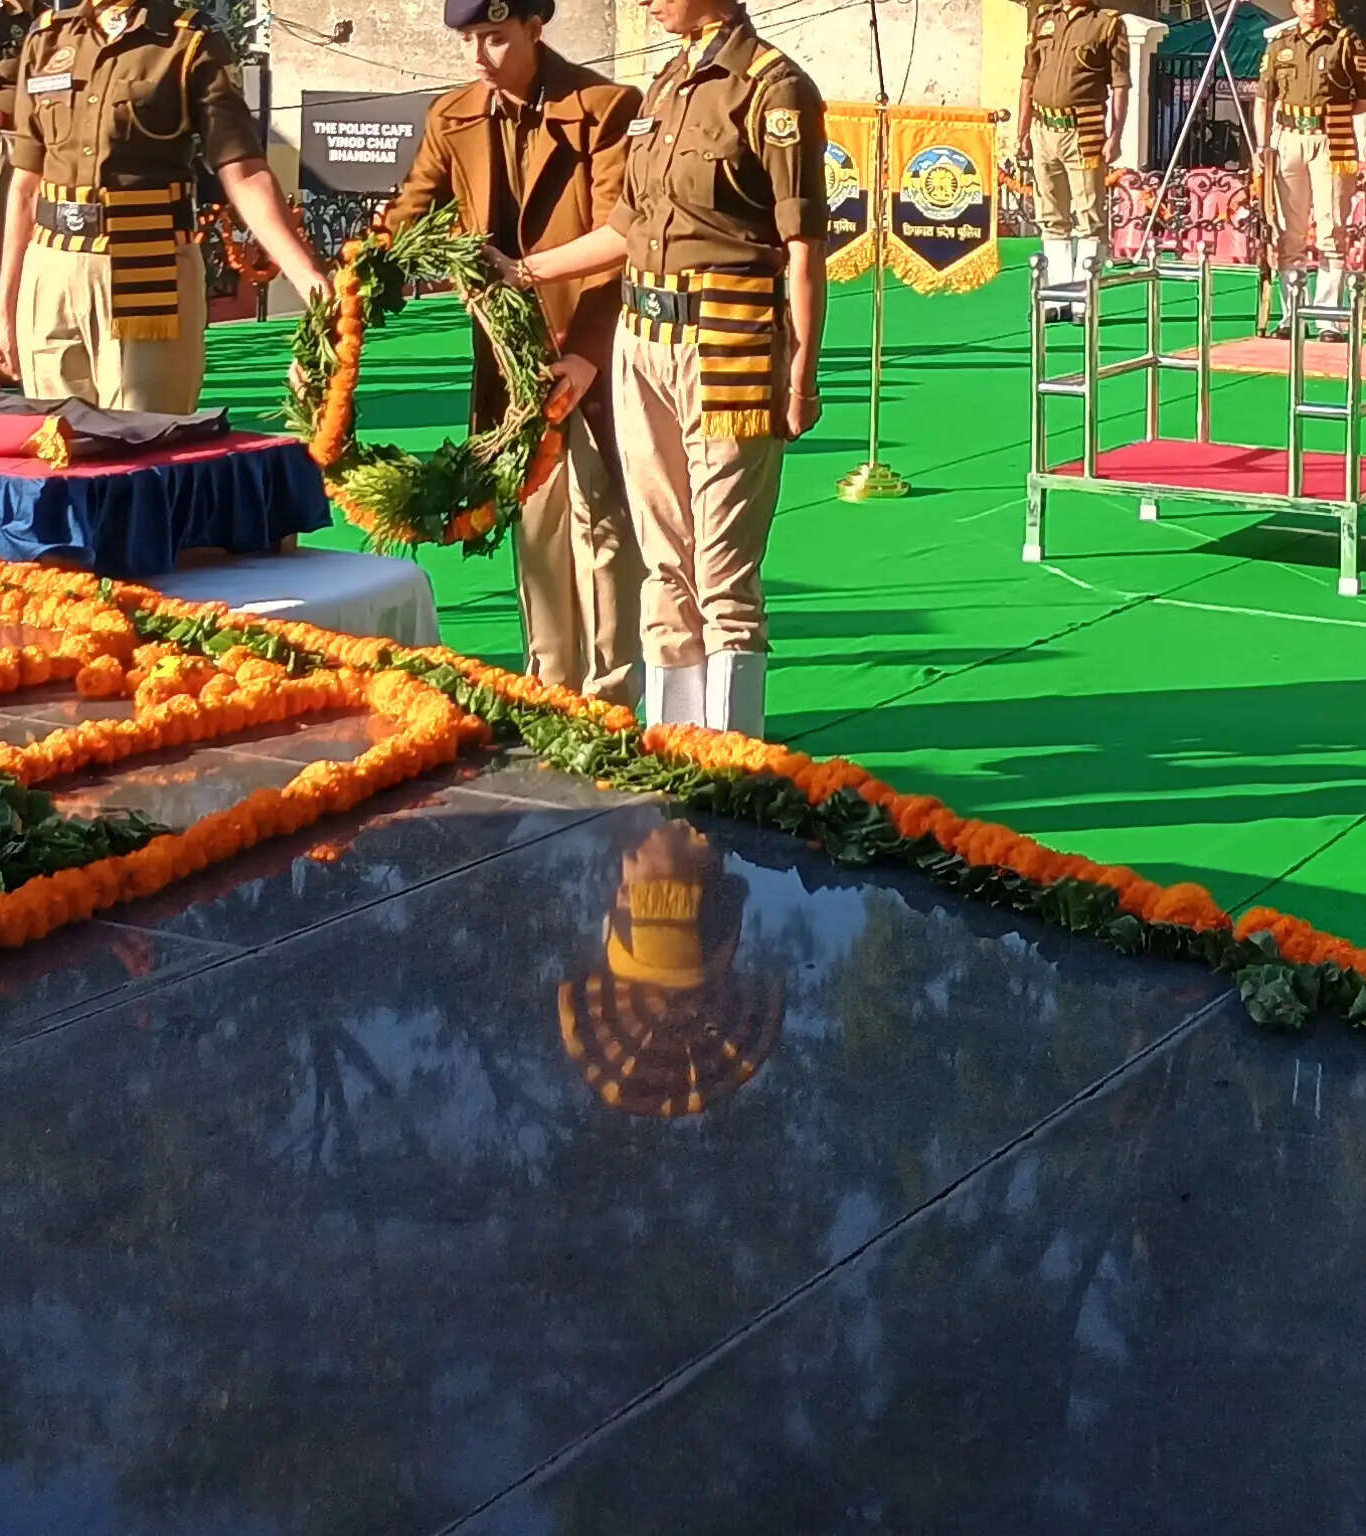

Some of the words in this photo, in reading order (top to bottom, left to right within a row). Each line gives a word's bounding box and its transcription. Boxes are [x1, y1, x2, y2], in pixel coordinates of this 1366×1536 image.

[312, 122, 337, 135] THE
[338, 123, 380, 136] POLICE
[381, 124, 413, 137] CAFE
[327, 136, 365, 149] VINOD
[366, 137, 399, 150] CHAT
